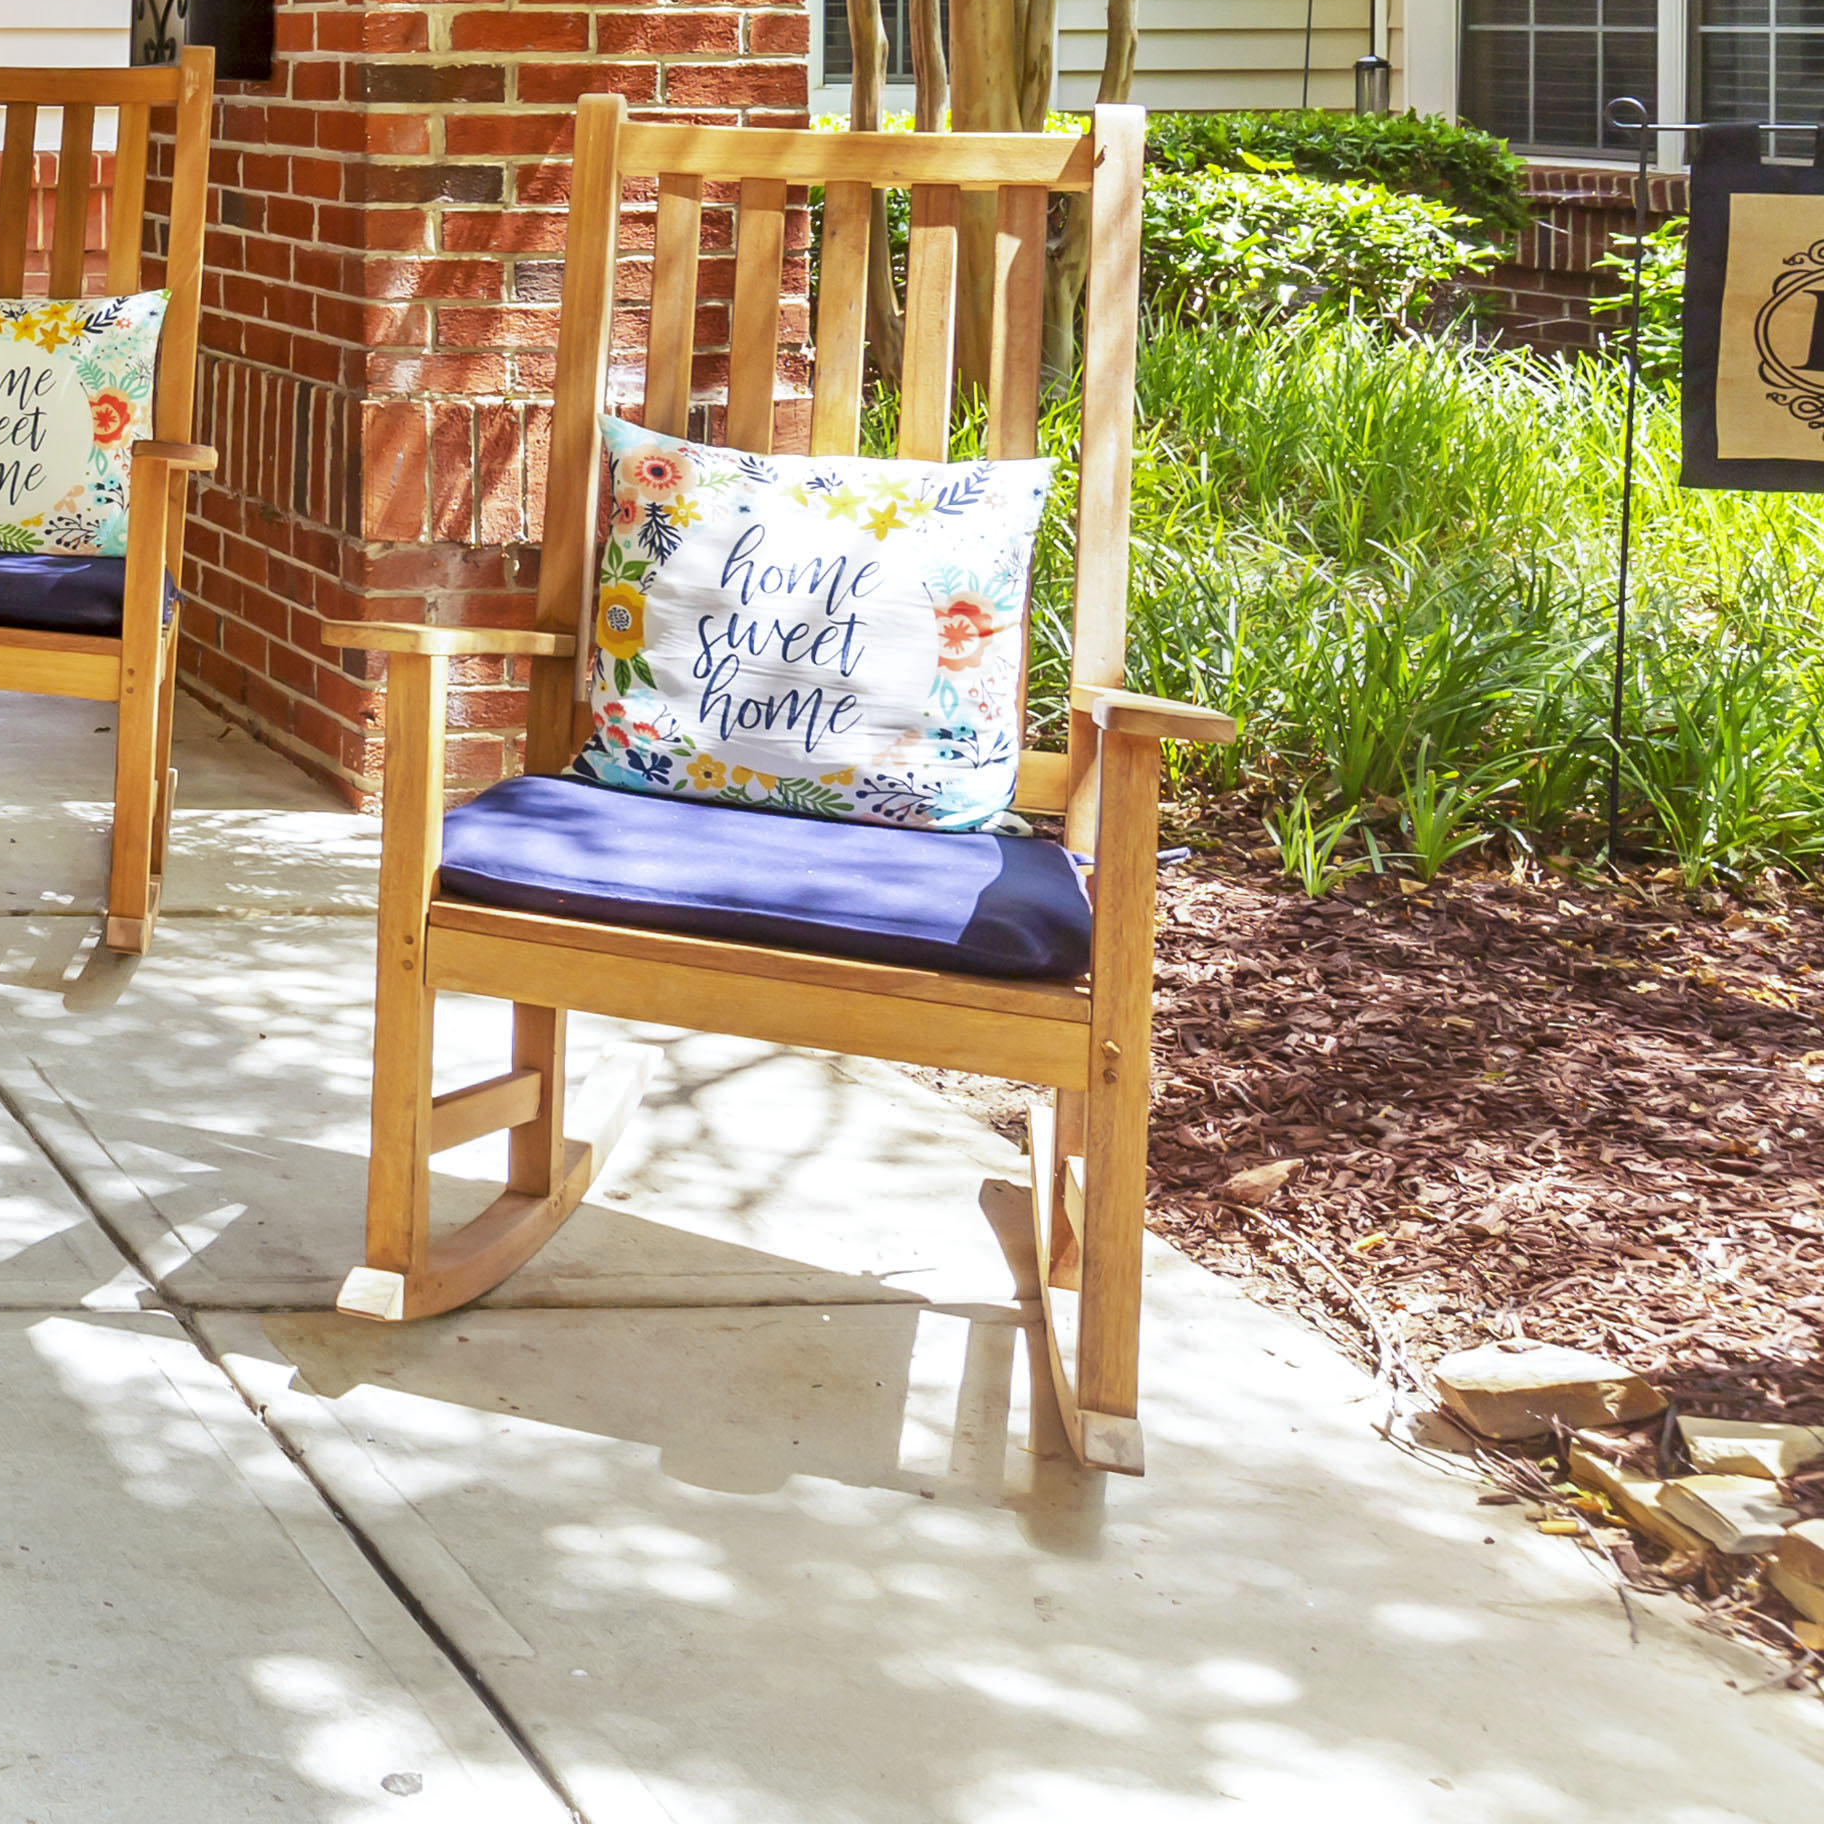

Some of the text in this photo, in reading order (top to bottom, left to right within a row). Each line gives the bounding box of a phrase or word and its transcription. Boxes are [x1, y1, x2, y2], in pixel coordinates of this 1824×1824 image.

[720, 524, 884, 615] home
[693, 613, 867, 679] sweet
[699, 654, 864, 754] home
